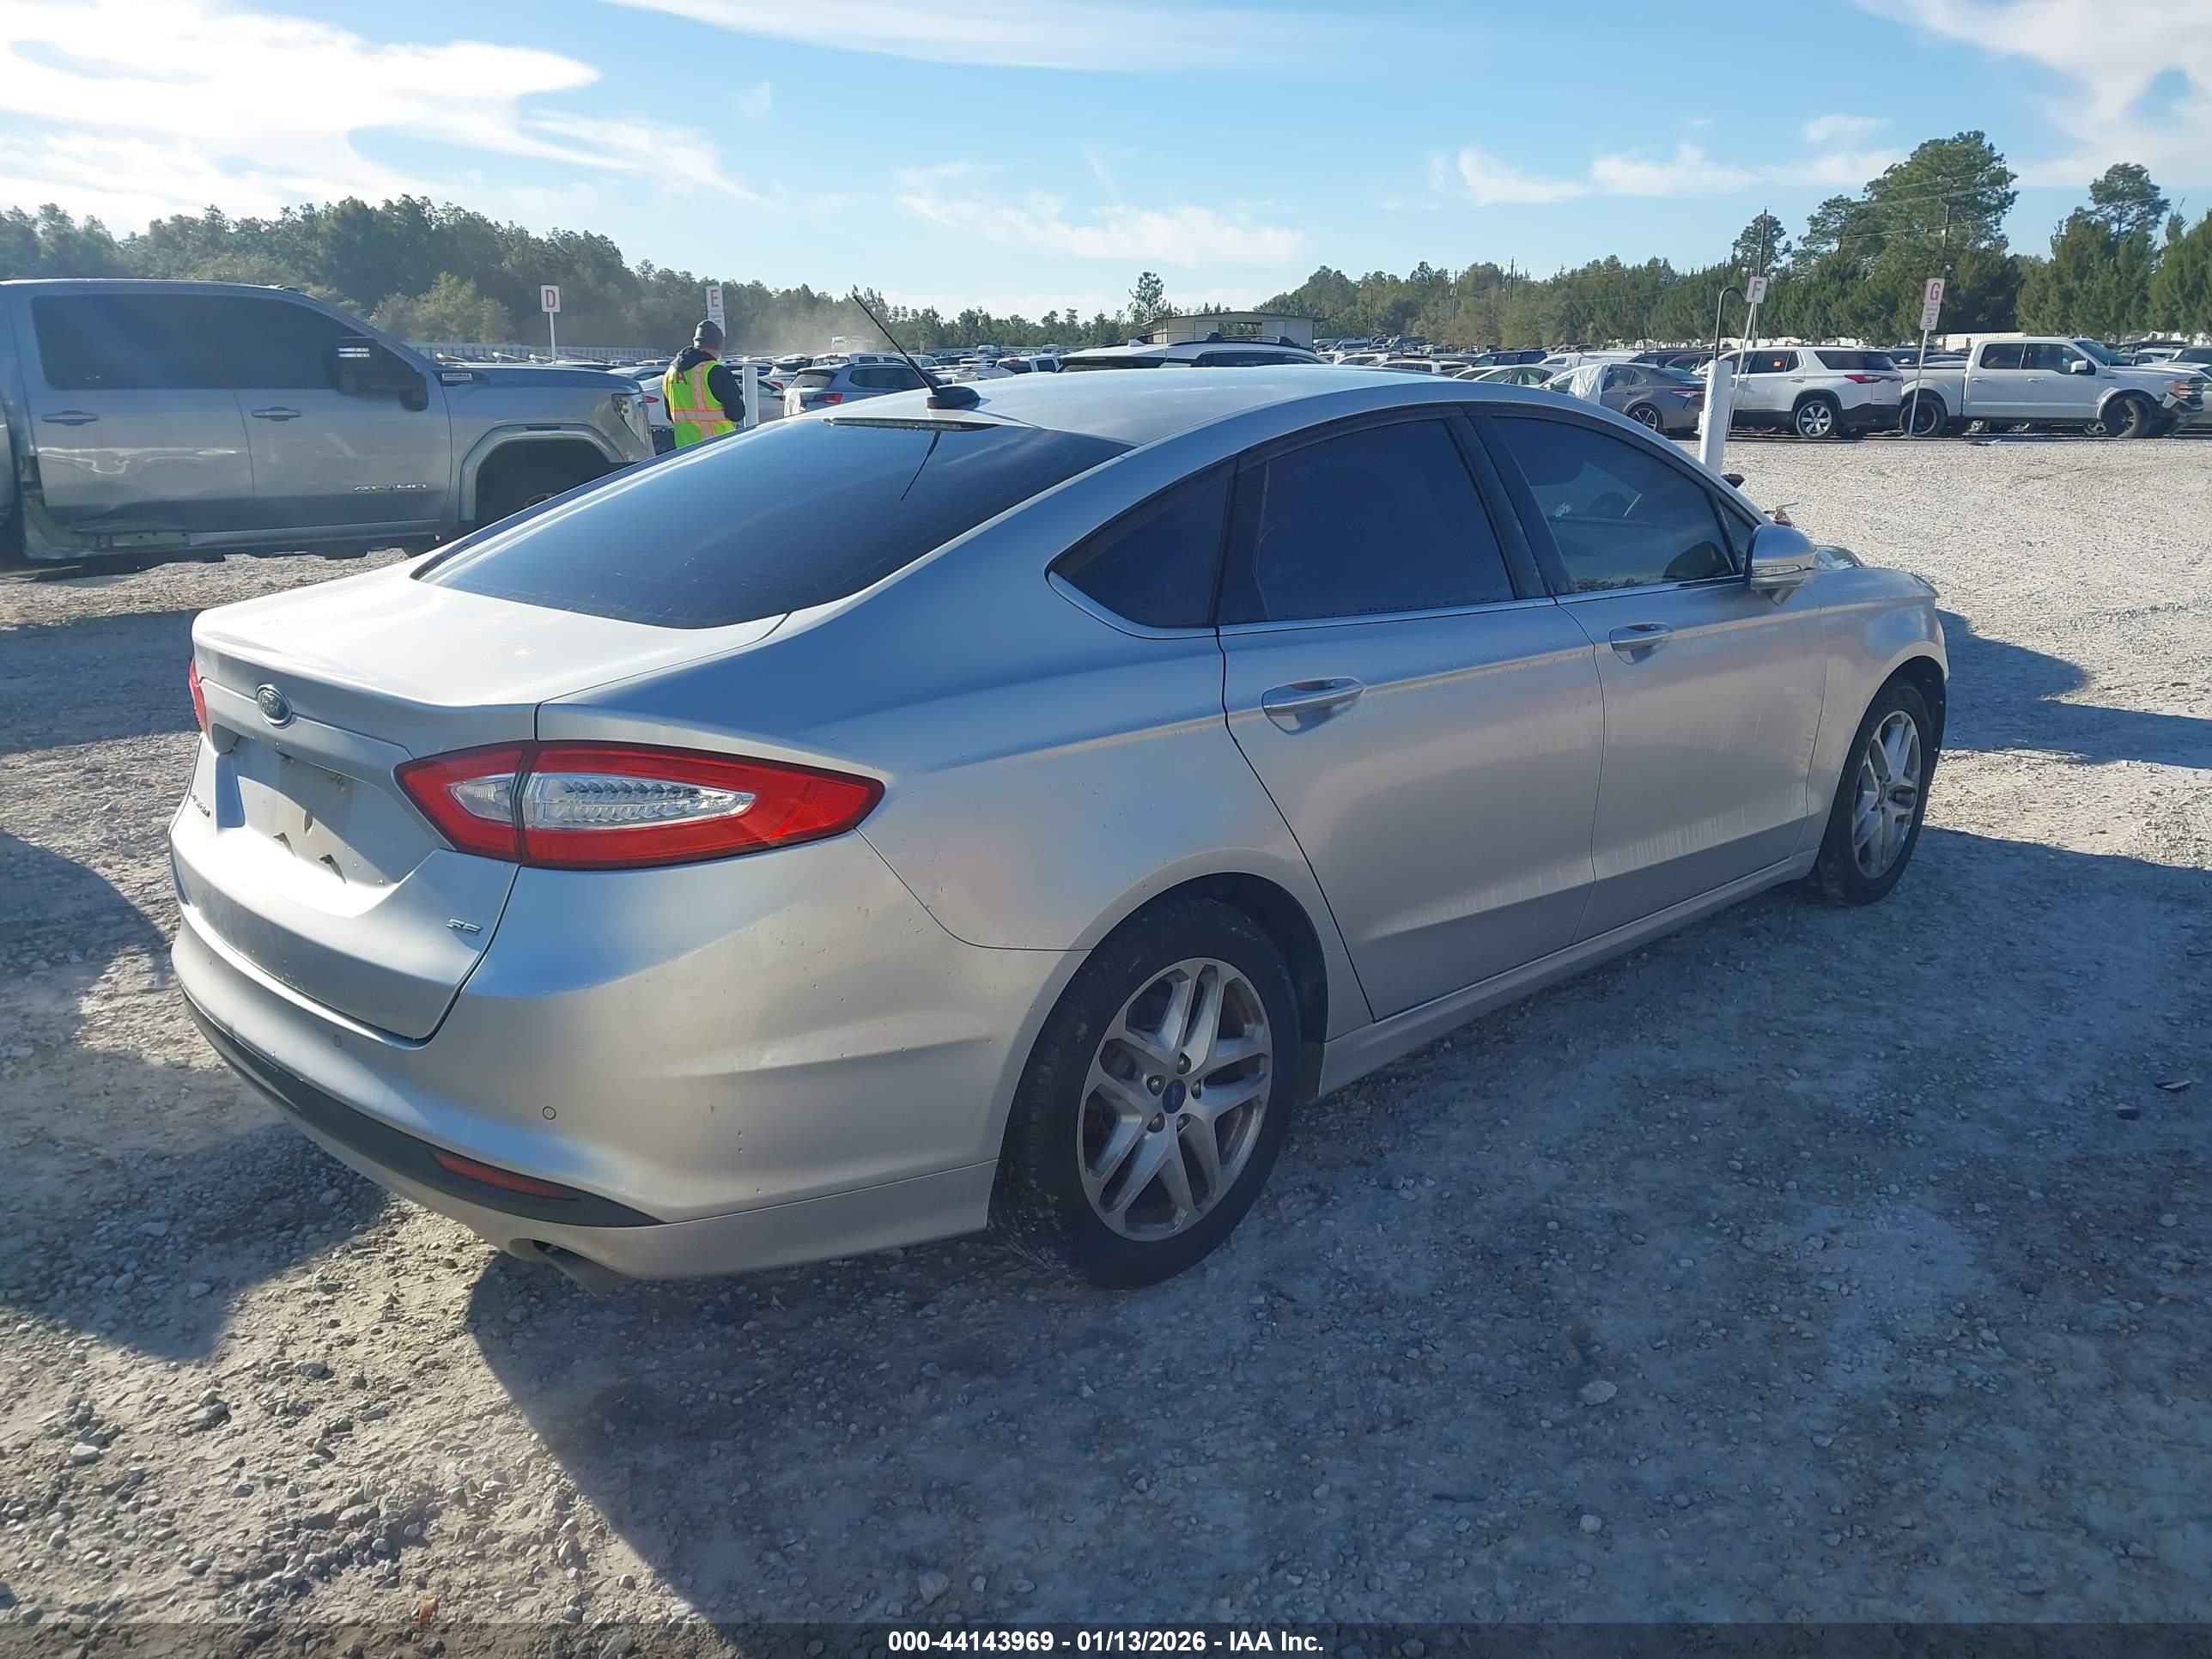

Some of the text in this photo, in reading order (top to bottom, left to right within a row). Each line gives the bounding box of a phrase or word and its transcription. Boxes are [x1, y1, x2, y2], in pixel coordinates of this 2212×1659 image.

[545, 289, 556, 307] D
[710, 289, 719, 307] E
[1752, 280, 1763, 299] F
[1929, 283, 1941, 301] G
[446, 918, 483, 935] SE
